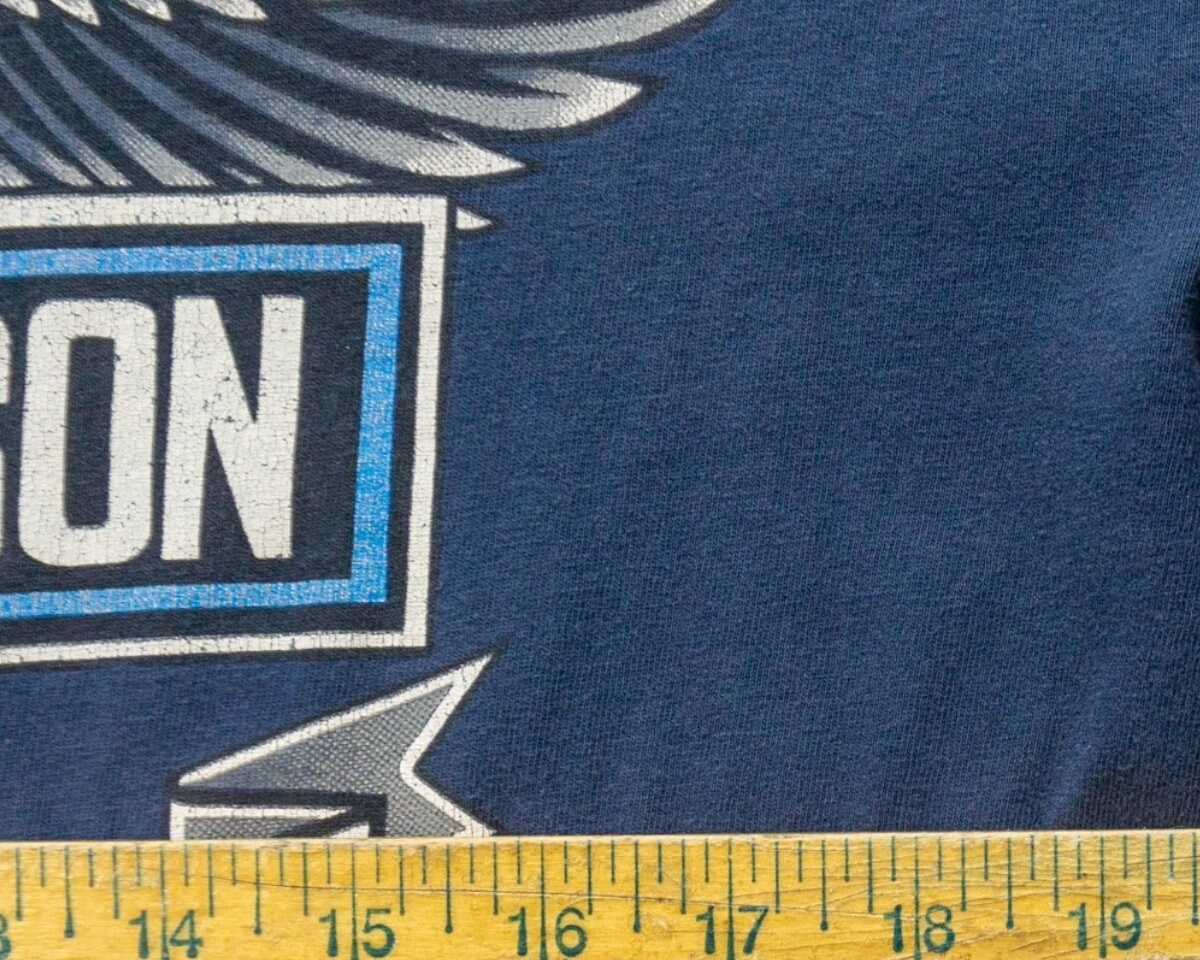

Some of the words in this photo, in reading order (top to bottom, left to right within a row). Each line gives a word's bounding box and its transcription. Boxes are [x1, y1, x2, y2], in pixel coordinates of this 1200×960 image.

[0, 295, 304, 567] ON
[129, 909, 204, 960] 14
[319, 907, 396, 959] 15
[508, 906, 588, 957] 16
[697, 905, 769, 955] 17
[884, 904, 955, 954] 18
[1068, 902, 1142, 951] 19
